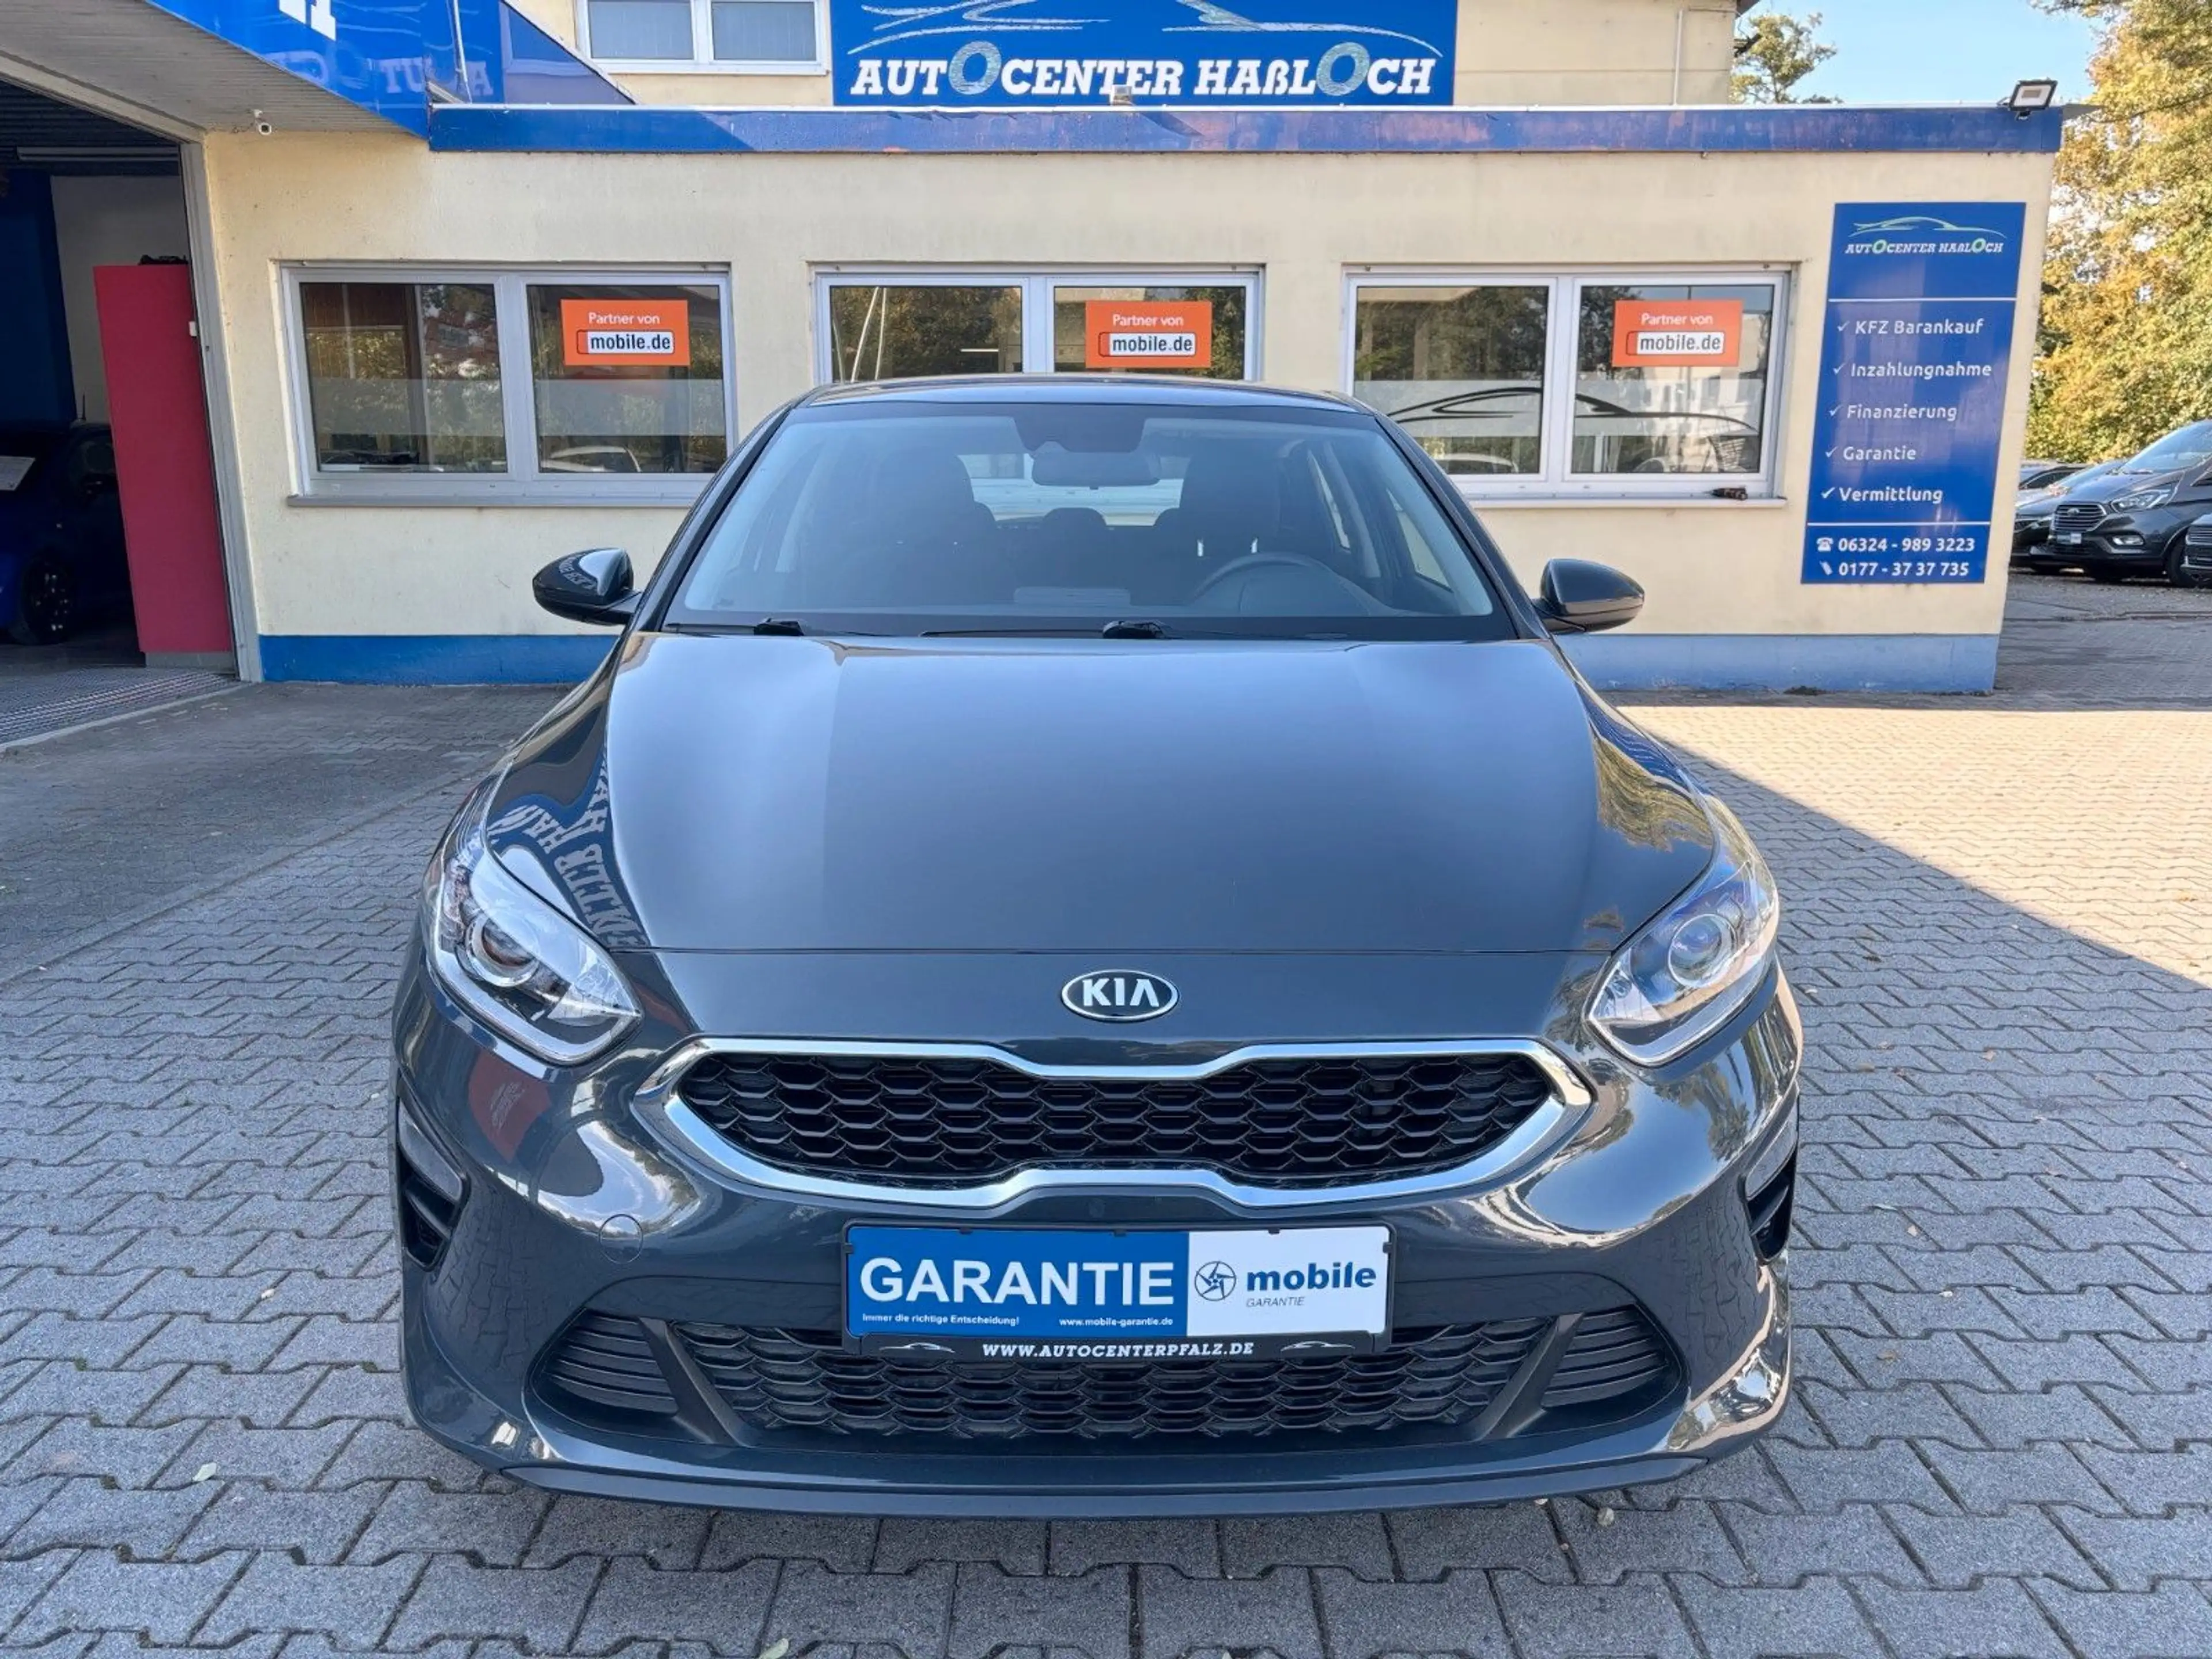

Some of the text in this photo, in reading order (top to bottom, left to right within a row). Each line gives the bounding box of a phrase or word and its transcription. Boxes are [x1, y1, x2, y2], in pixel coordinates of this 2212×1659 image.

[850, 41, 1436, 96] AUTOCENTER HAßLOCH
[1844, 239, 1936, 255] AUTOCENTER
[588, 312, 660, 324] Partner von
[1112, 314, 1184, 326] Partner von
[1642, 313, 1713, 325] Partner von
[1855, 319, 1984, 335] KFZ Barankauf
[591, 334, 671, 350] mobile.de
[1112, 336, 1193, 352] mobile.de
[1641, 335, 1721, 351] mobile.de
[1851, 362, 1992, 380] Inzahlungnahme
[1847, 404, 1958, 421] Finanzierung
[1843, 446, 1917, 461] Garantie
[1839, 487, 1944, 505] Vermittlung
[1838, 538, 1887, 552] 06324
[1902, 538, 1931, 552] 989
[1936, 538, 1975, 552] 3223
[1838, 562, 1878, 576] 0177
[1892, 562, 1912, 576] 37
[1912, 562, 1936, 576] 37
[1941, 562, 1969, 576] 735
[1082, 977, 1160, 1007] KIA
[860, 1257, 1174, 1306] GARANTIE
[1246, 1262, 1377, 1291] mobile
[1245, 1296, 1305, 1308] GARANTIE
[862, 1313, 1020, 1327] Immer die richtige Entscheidung!
[1059, 1317, 1173, 1328] www.mobile-garantie.de
[982, 1342, 1255, 1358] WWW.AUTOCENTERPFALZ.DE
